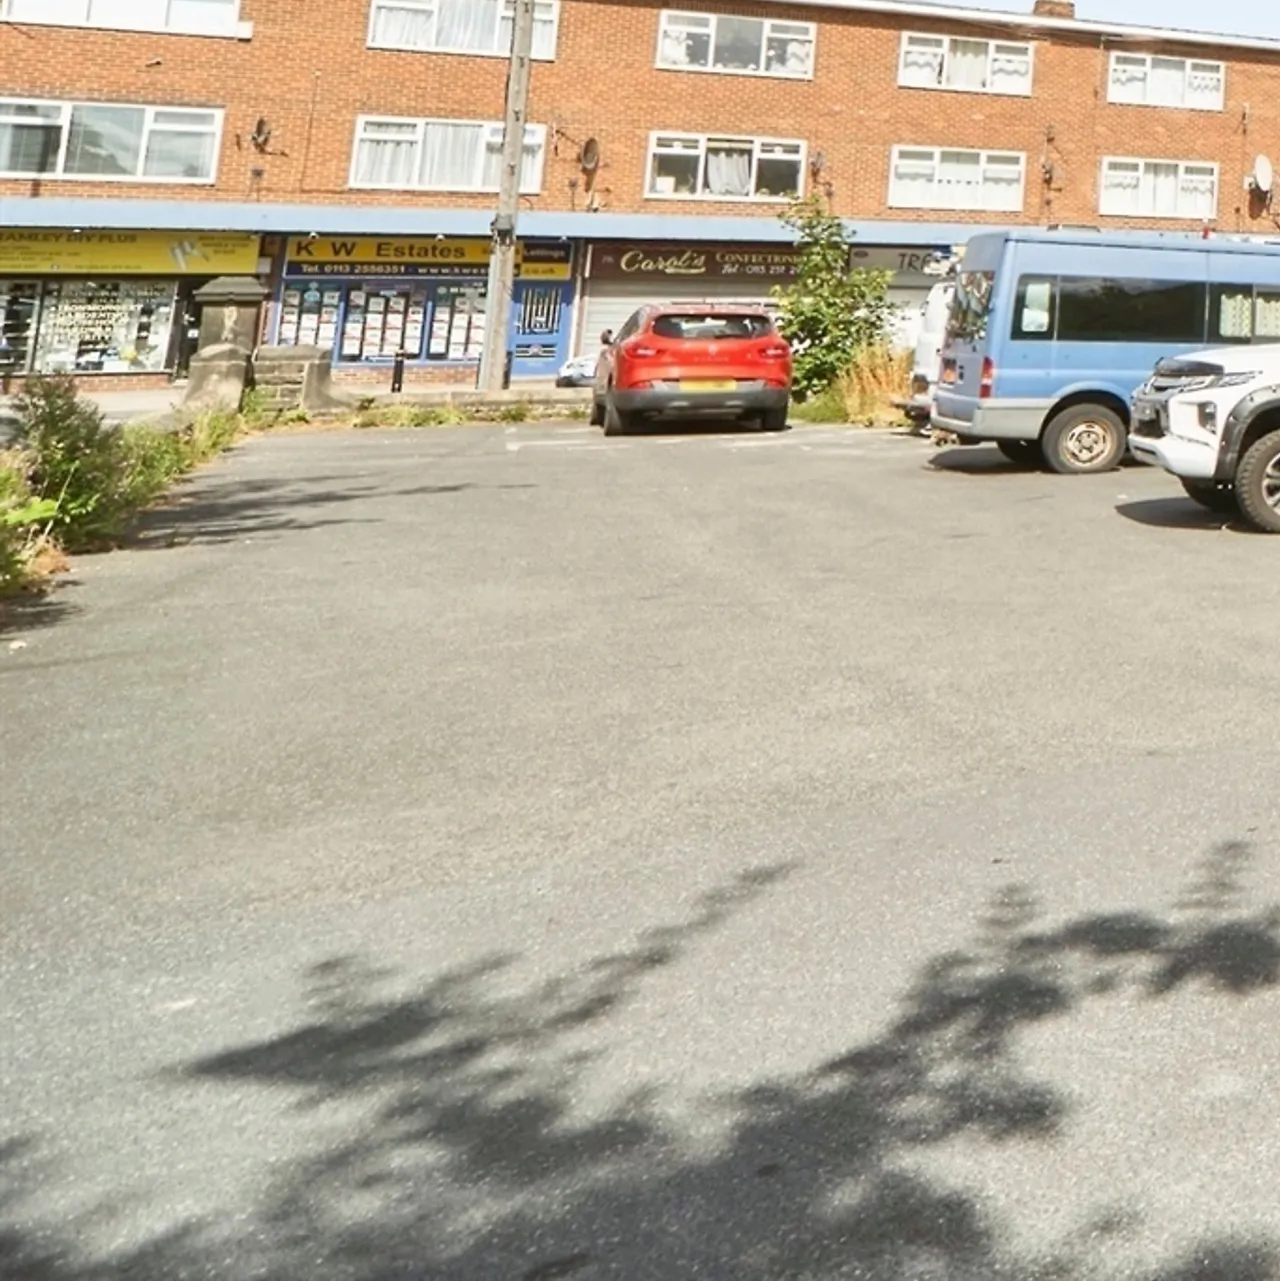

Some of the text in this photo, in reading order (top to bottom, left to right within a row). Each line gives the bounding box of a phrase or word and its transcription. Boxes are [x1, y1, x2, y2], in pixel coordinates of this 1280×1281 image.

[66, 233, 96, 243] DIY
[97, 234, 137, 243] PLUS
[295, 241, 315, 257] K
[330, 241, 356, 257] W
[375, 241, 466, 258] Estates
[324, 264, 351, 274] 0113
